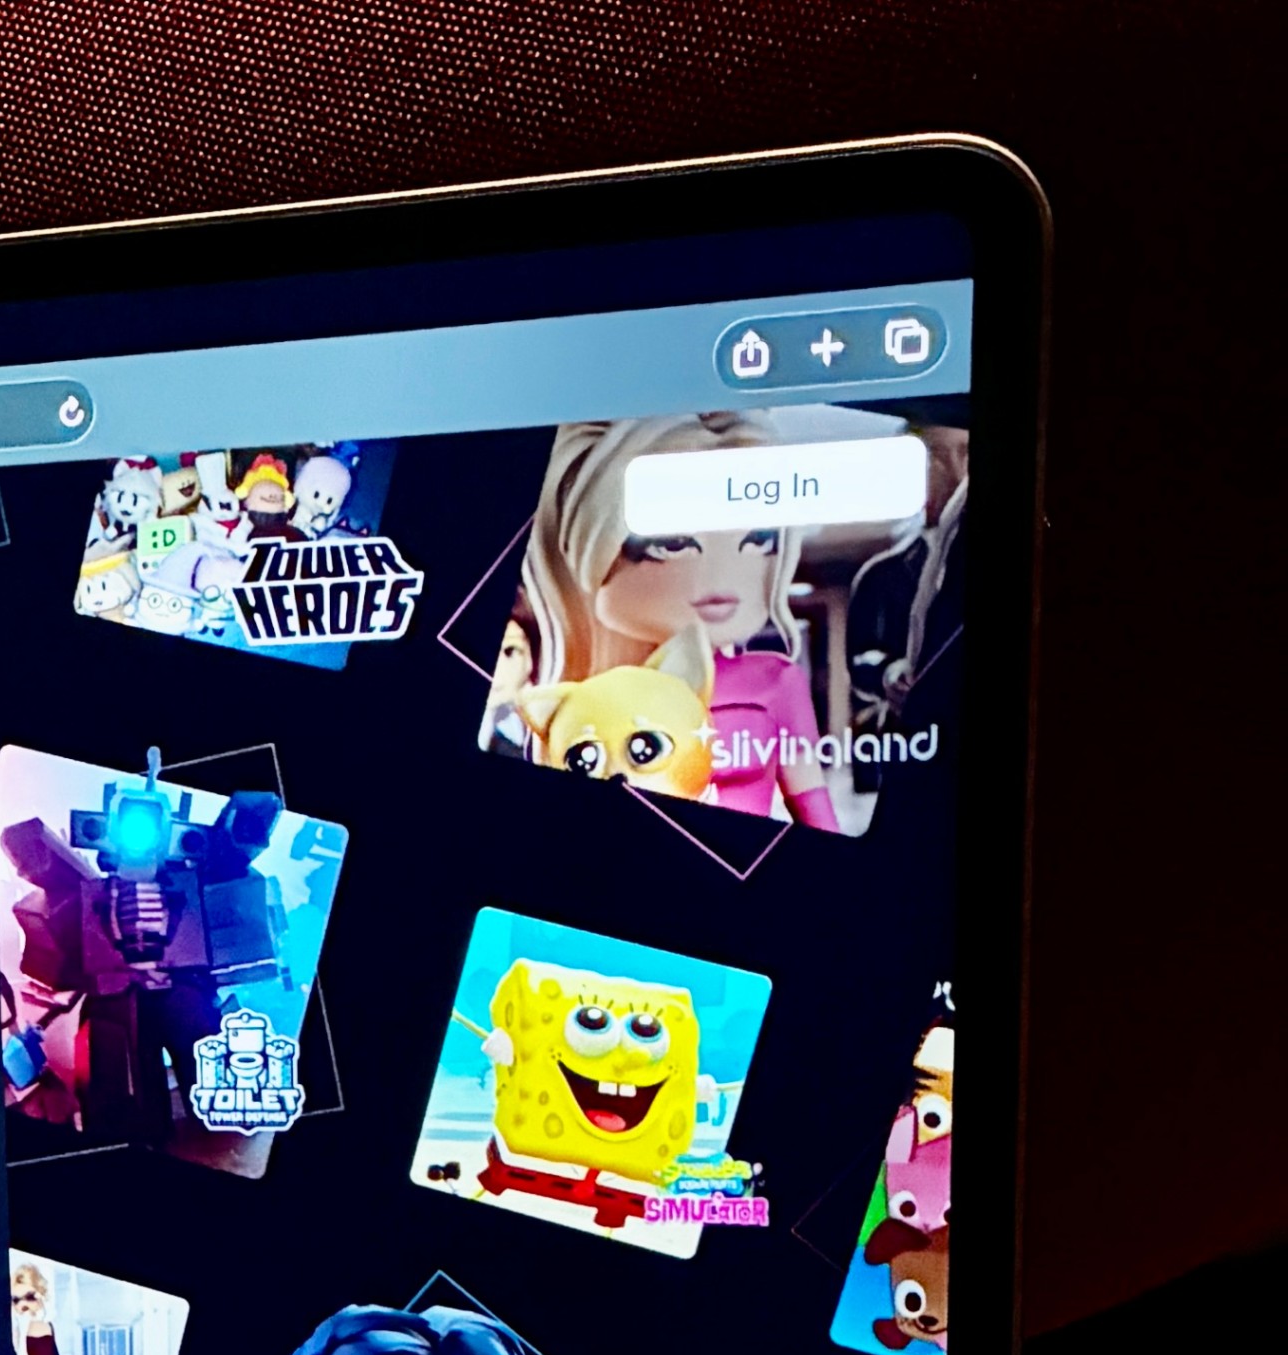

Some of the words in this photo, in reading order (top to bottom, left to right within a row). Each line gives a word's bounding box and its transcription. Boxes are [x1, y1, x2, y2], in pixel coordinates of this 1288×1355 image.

[725, 476, 780, 507] Log
[793, 472, 821, 500] In
[241, 542, 409, 583] TOWER
[232, 577, 418, 640] HEROES
[710, 723, 939, 769] slivingland
[195, 1088, 300, 1111] TOILET
